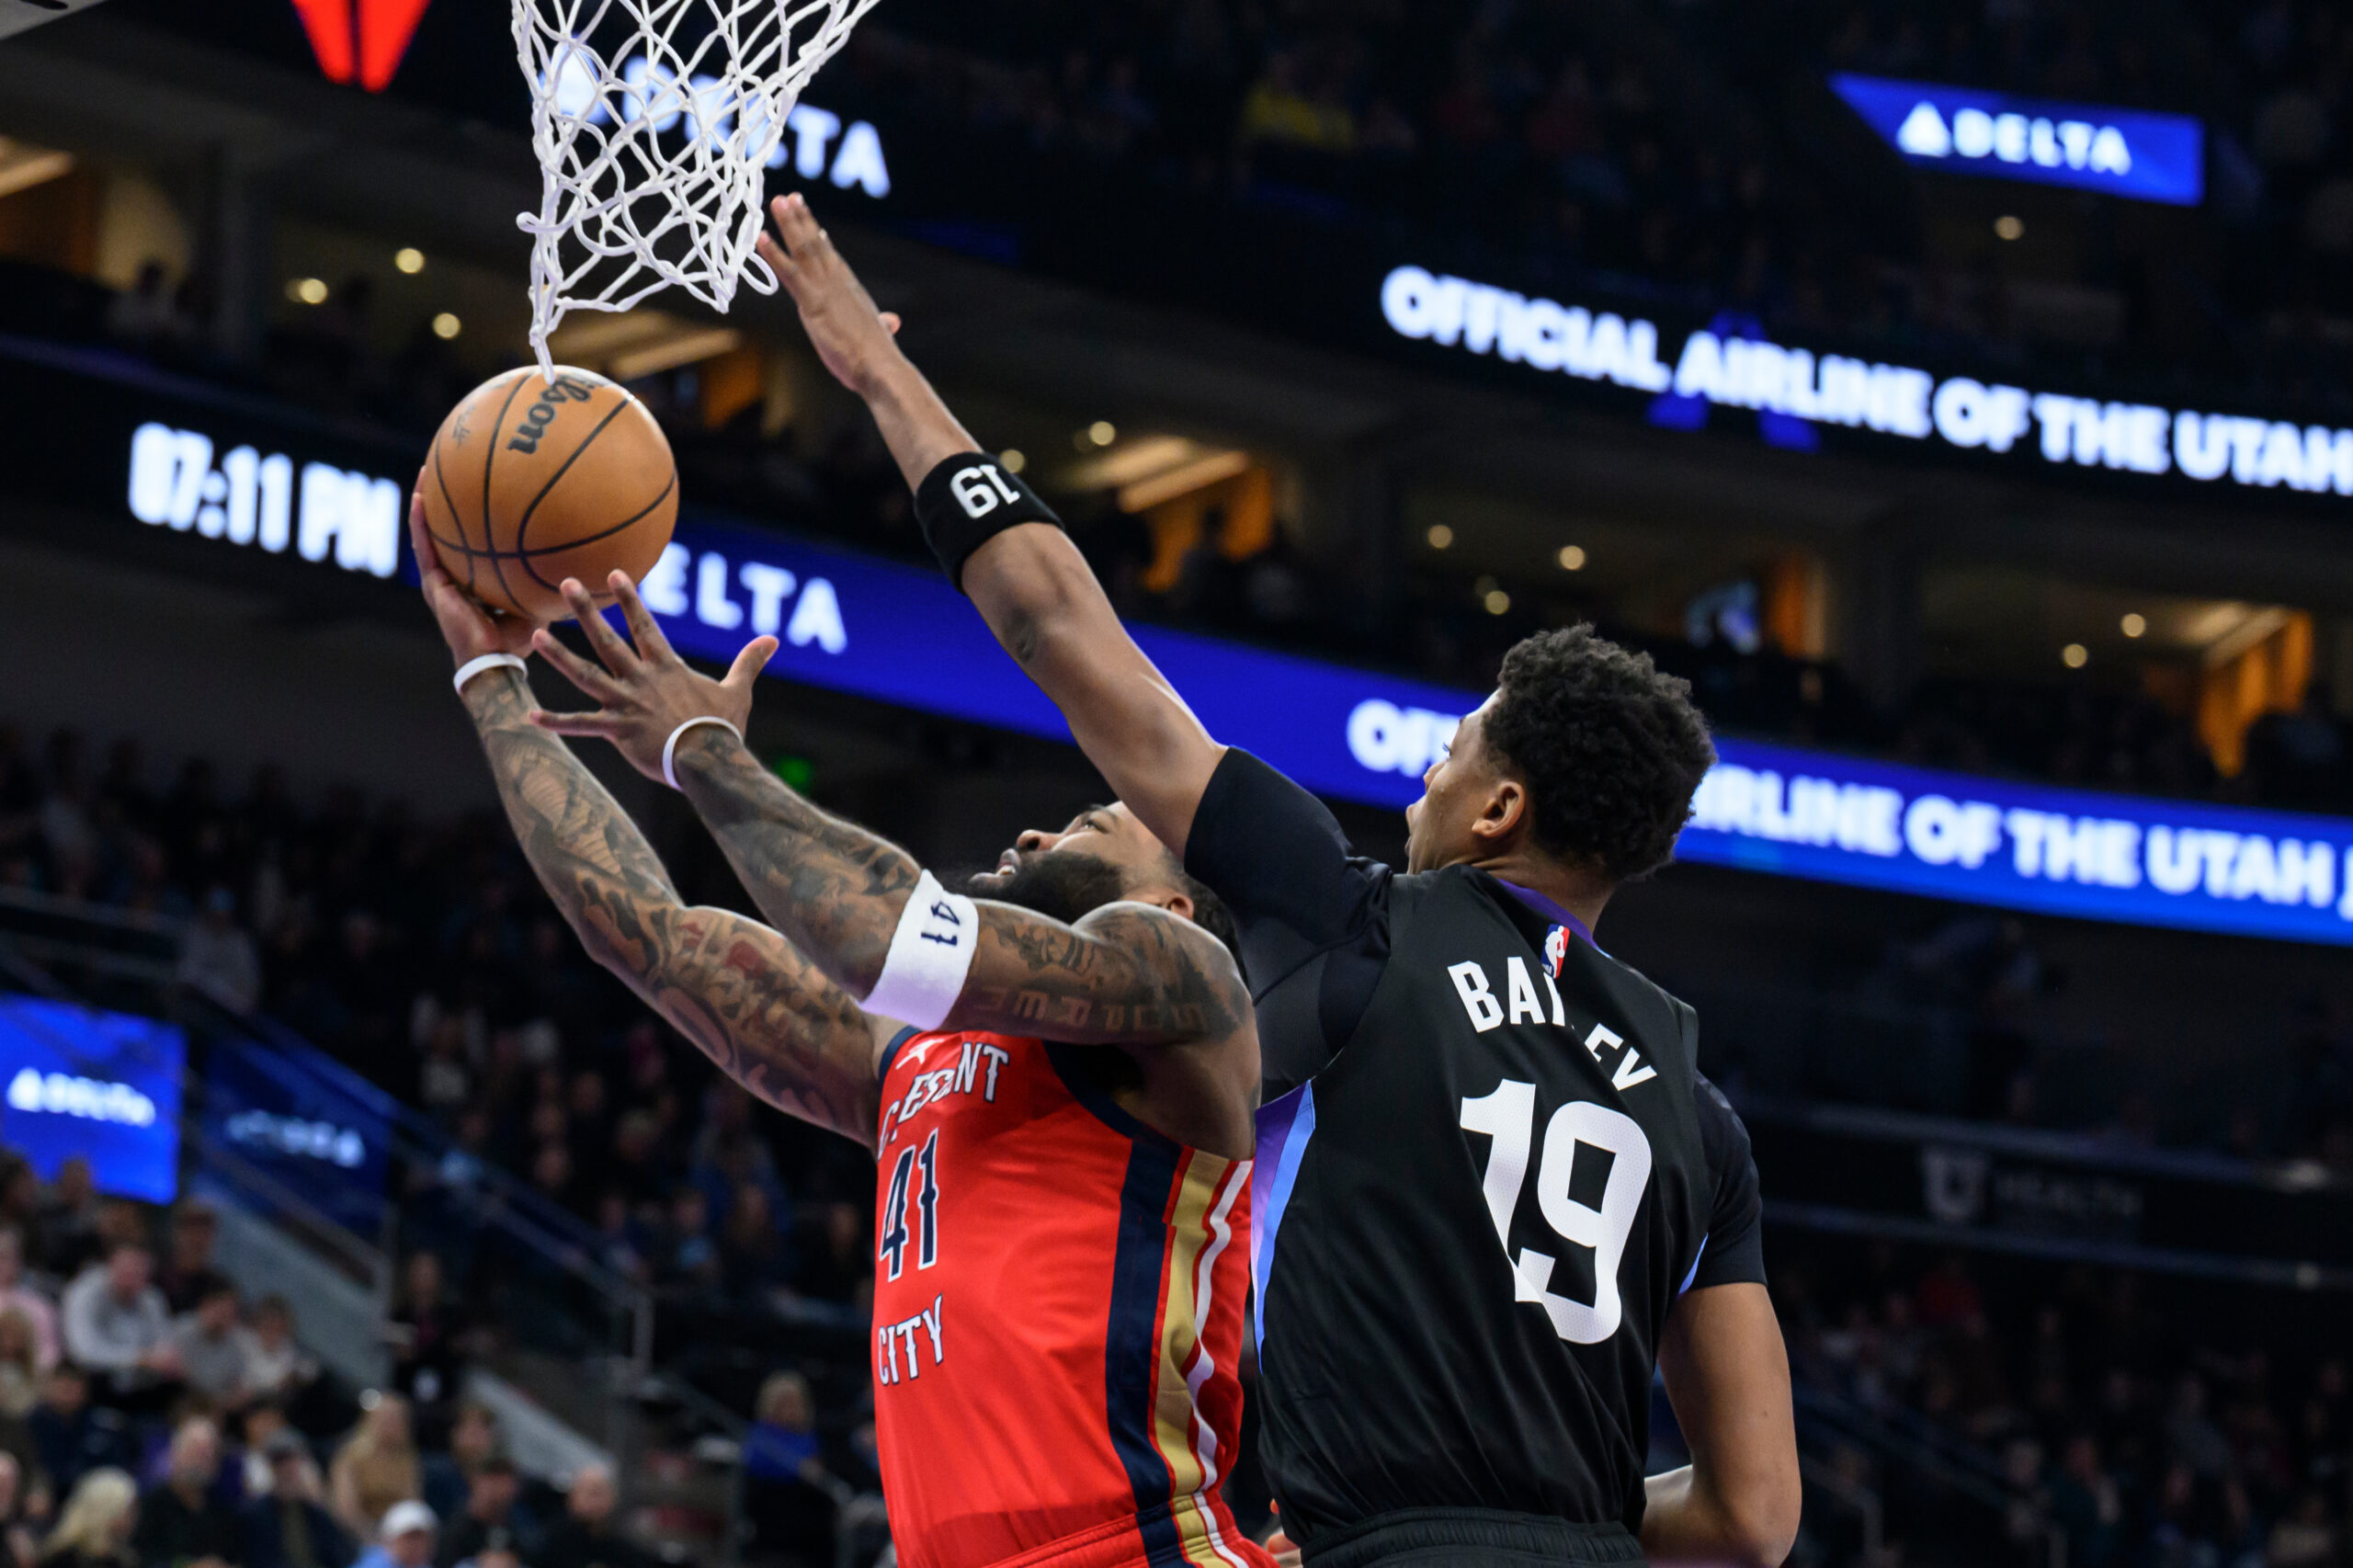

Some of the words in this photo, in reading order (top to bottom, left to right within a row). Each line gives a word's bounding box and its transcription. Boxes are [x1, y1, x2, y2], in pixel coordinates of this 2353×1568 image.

[1952, 108, 2132, 176] DELTA
[506, 373, 596, 455] ilson
[1381, 265, 1673, 393] OFFICIAL
[1673, 330, 1933, 439] AIRLINE
[1932, 377, 2030, 453] OF
[2030, 392, 2170, 474] THE
[2174, 410, 2353, 496] UTAH
[129, 421, 293, 553] 07:11
[298, 461, 401, 578] PM
[638, 541, 847, 654] ELTA
[1684, 763, 1902, 858] IRLINE
[1904, 793, 2002, 869] OF
[2003, 806, 2143, 891] THE
[2146, 824, 2336, 909] UTAH
[921, 901, 961, 947] 41
[879, 1127, 939, 1283] 41
[1460, 1078, 1652, 1345] 19
[878, 1292, 944, 1386] CITY
